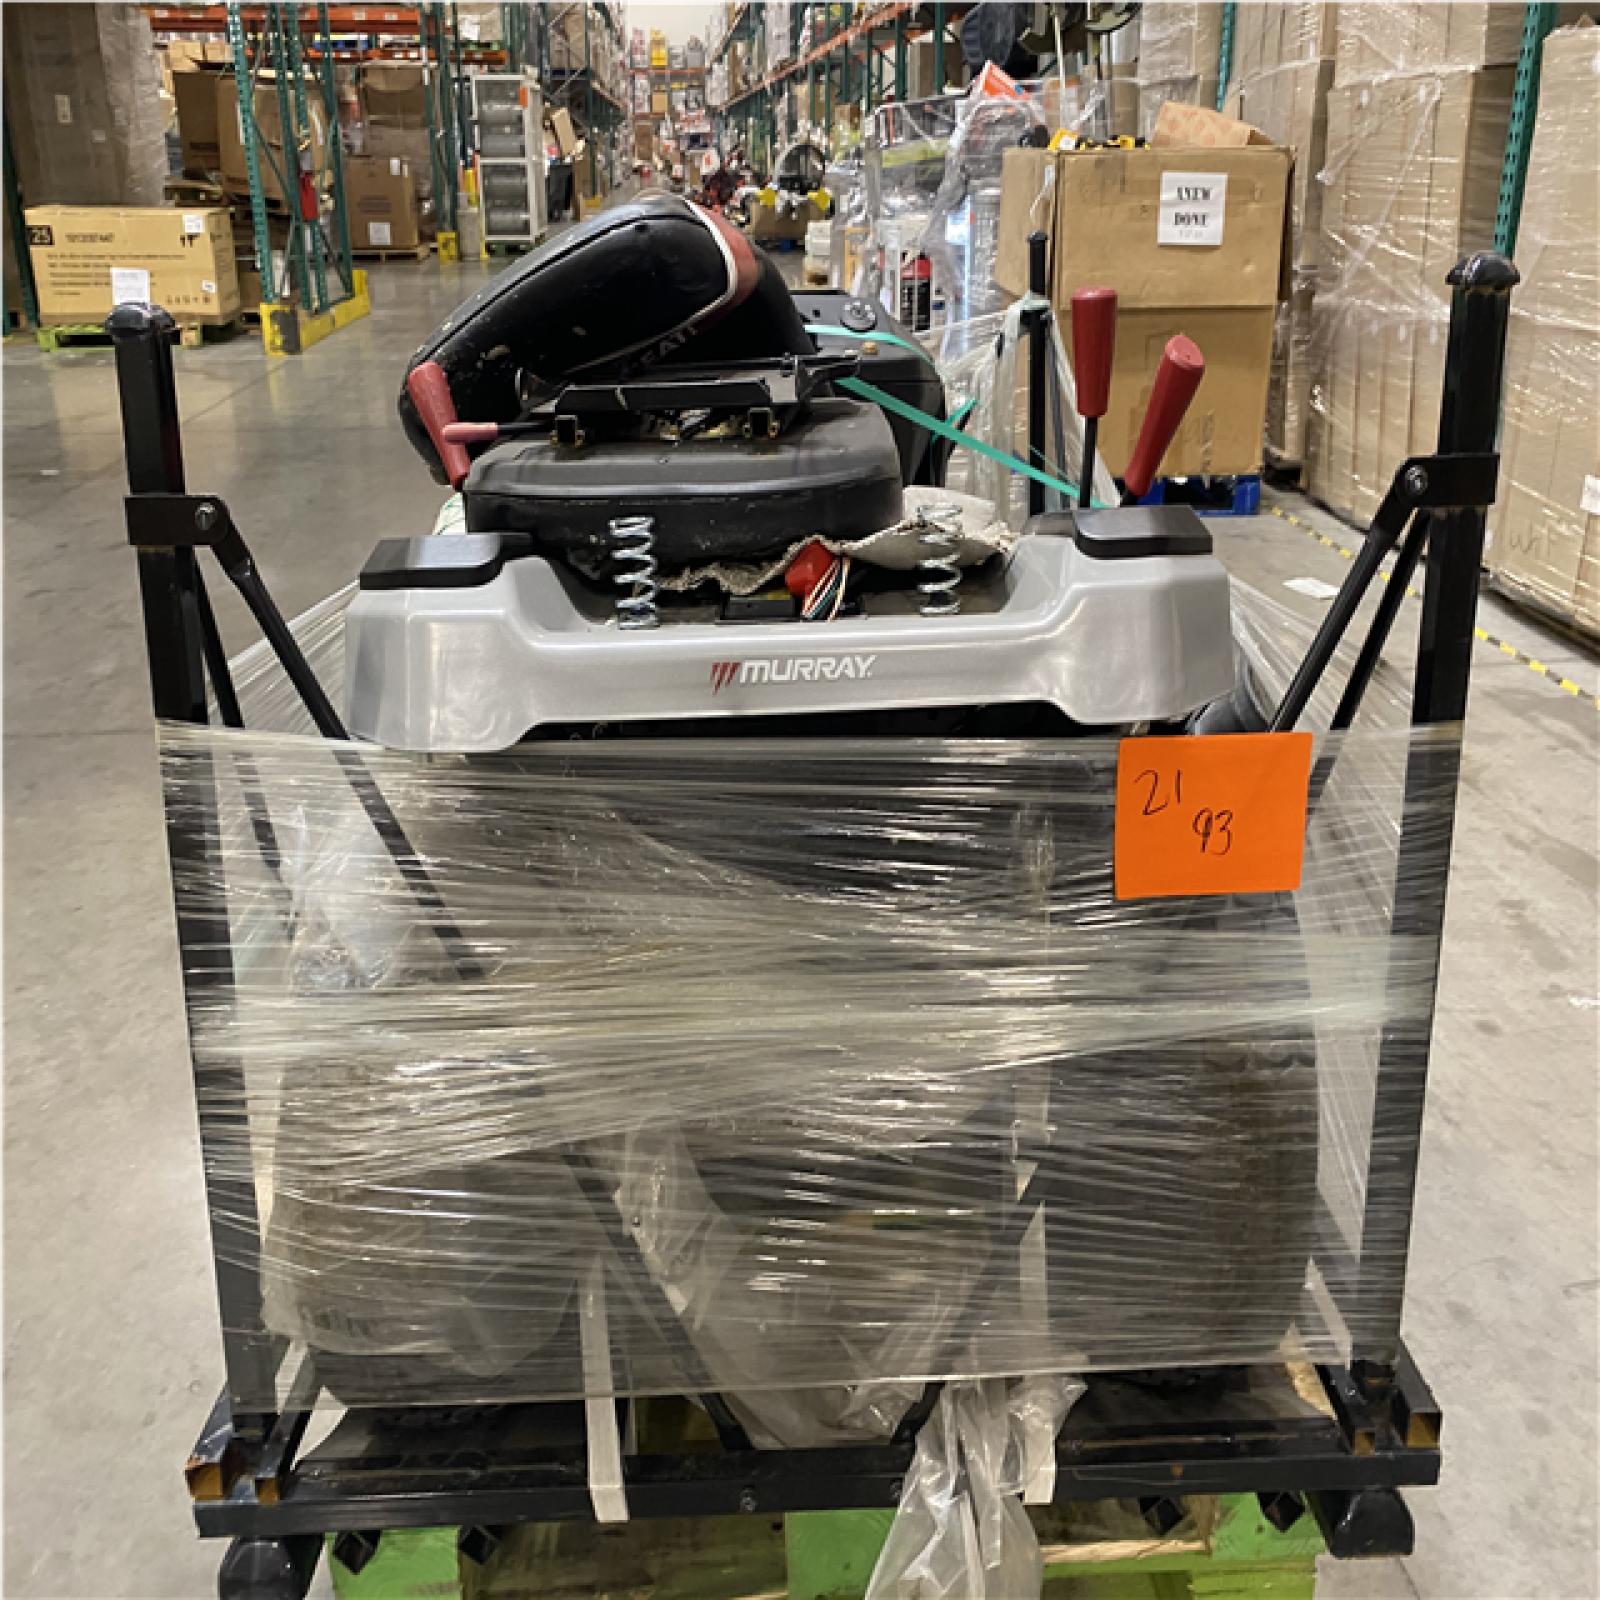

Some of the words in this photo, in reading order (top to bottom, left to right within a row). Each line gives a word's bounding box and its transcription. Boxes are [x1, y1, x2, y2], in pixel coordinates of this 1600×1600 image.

[738, 654, 877, 684] MURRAY
[1134, 769, 1183, 816] 21
[1192, 807, 1234, 856] 93
